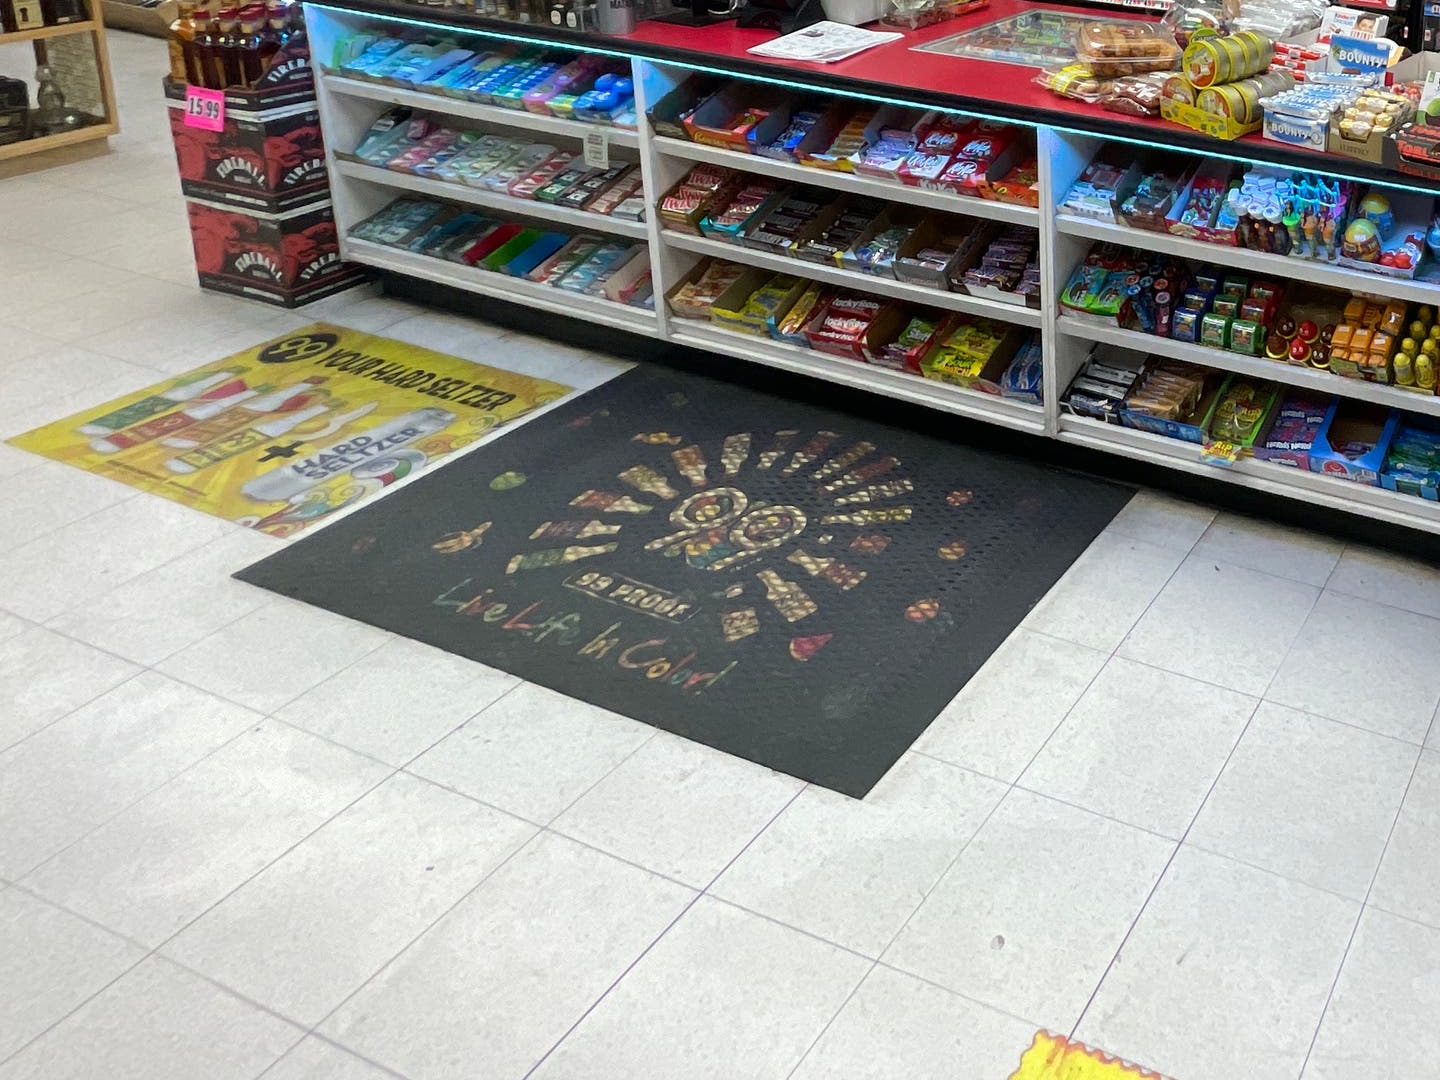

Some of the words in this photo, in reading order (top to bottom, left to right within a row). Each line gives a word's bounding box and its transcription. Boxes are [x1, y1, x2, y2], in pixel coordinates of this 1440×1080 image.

[267, 57, 312, 83] FIREB
[1338, 50, 1388, 69] BOUNTY
[1271, 122, 1311, 140] BOUNTY
[216, 155, 266, 187] FIREBALL
[284, 157, 326, 186] FIREB
[234, 251, 283, 283] FIREBALL
[300, 252, 337, 280] FIREB
[315, 347, 375, 376] YOUR
[373, 362, 436, 389] HARD
[417, 376, 517, 412] SELTZER
[291, 435, 373, 474] HARD
[303, 425, 425, 480] SELTZER
[609, 584, 692, 618] PROOF
